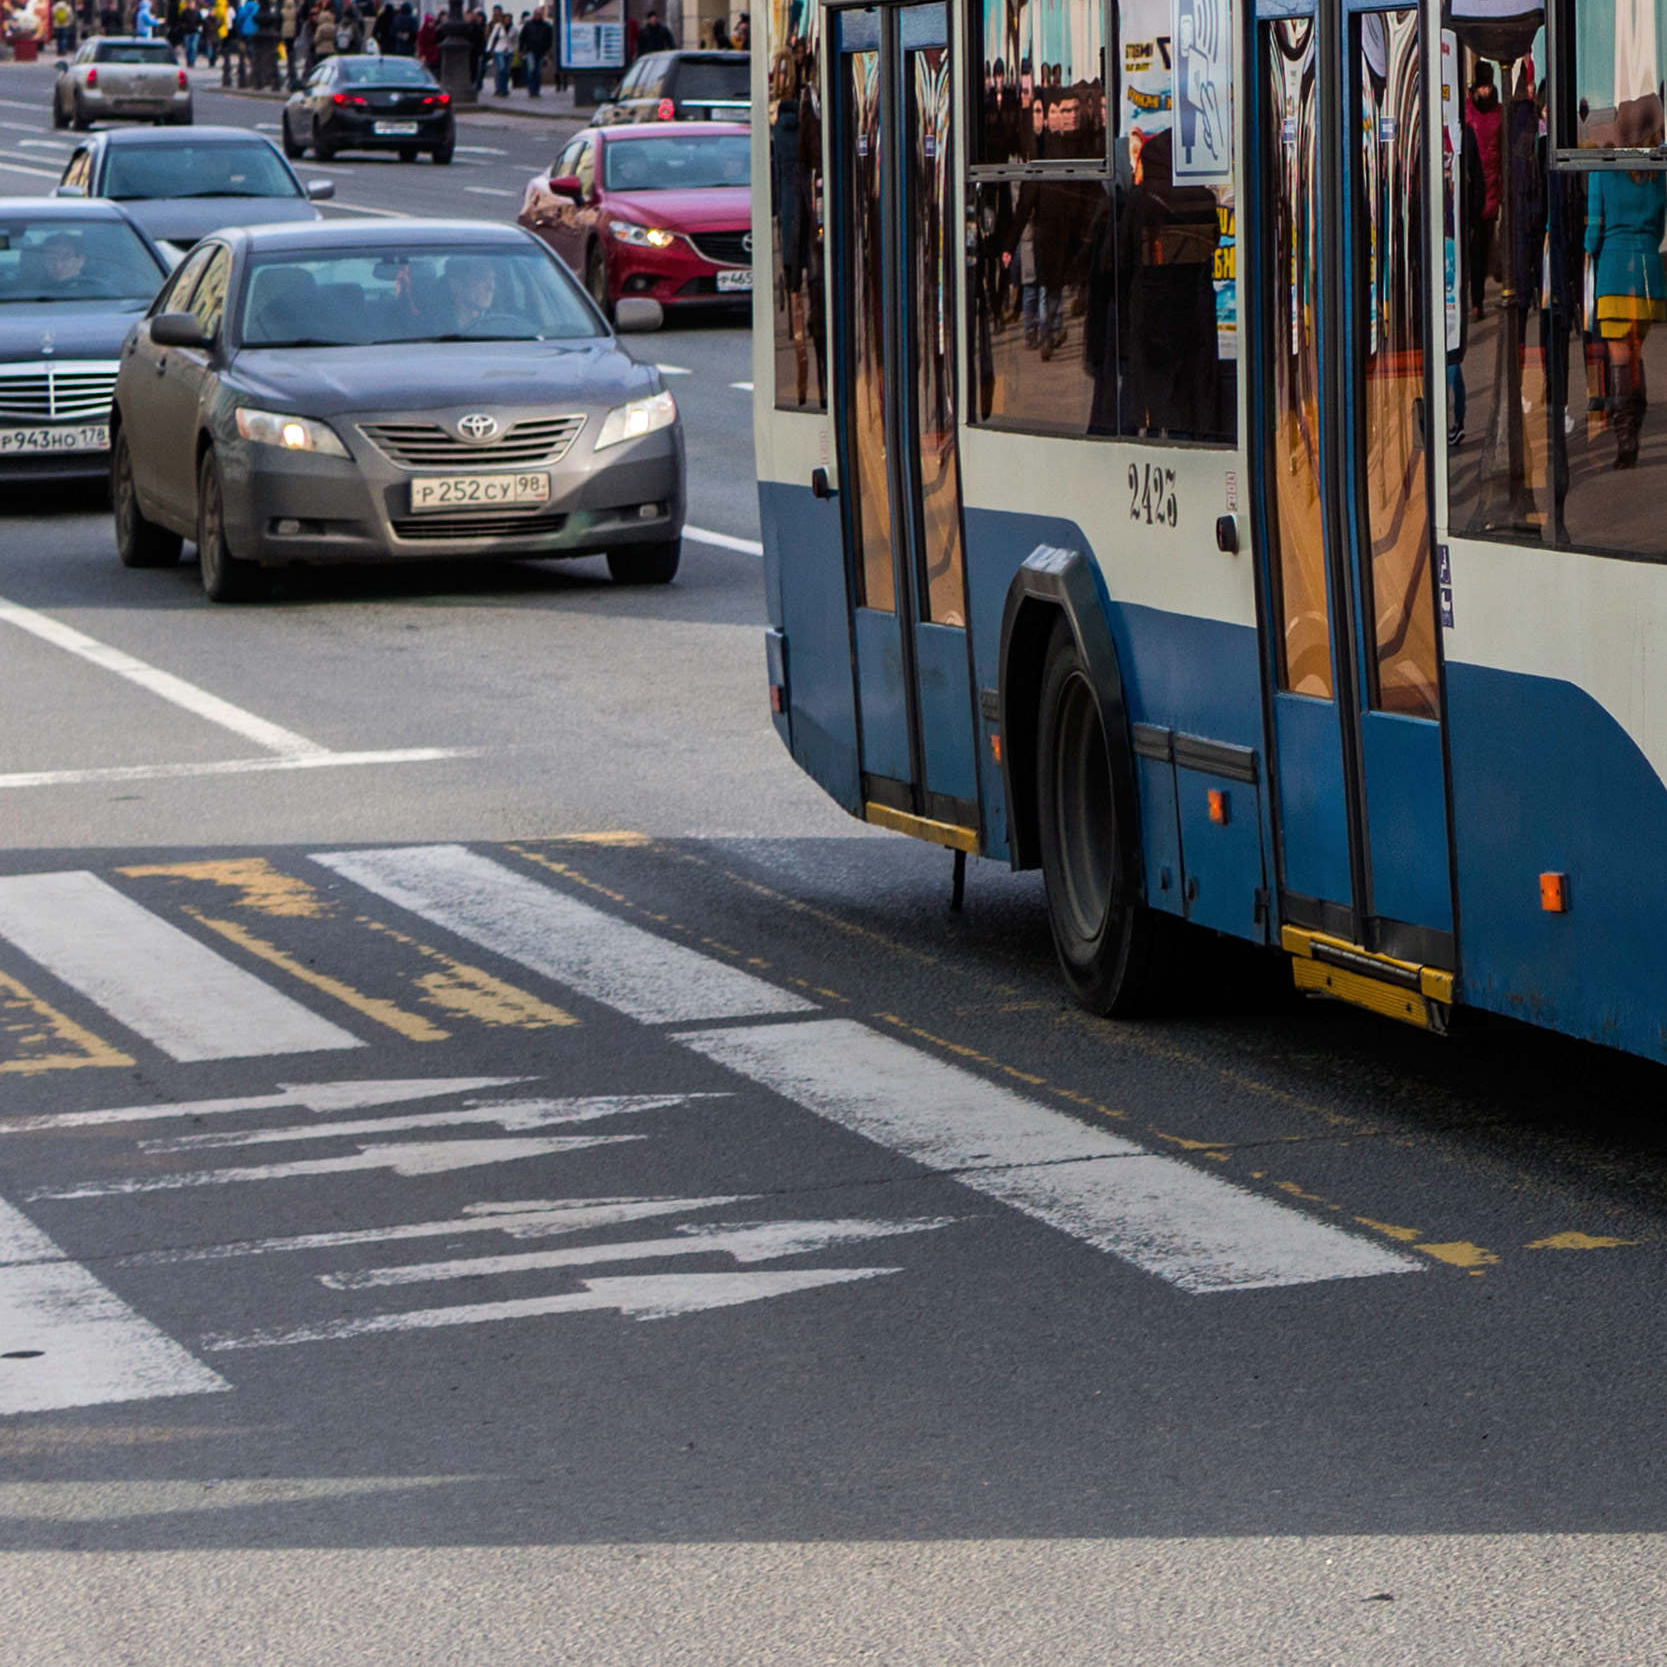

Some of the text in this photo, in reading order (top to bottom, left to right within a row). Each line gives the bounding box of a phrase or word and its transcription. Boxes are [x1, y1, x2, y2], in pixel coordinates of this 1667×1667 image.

[80, 428, 106, 442] 178
[422, 476, 540, 502] Р252СУ 98
[1128, 462, 1178, 528] 2423
